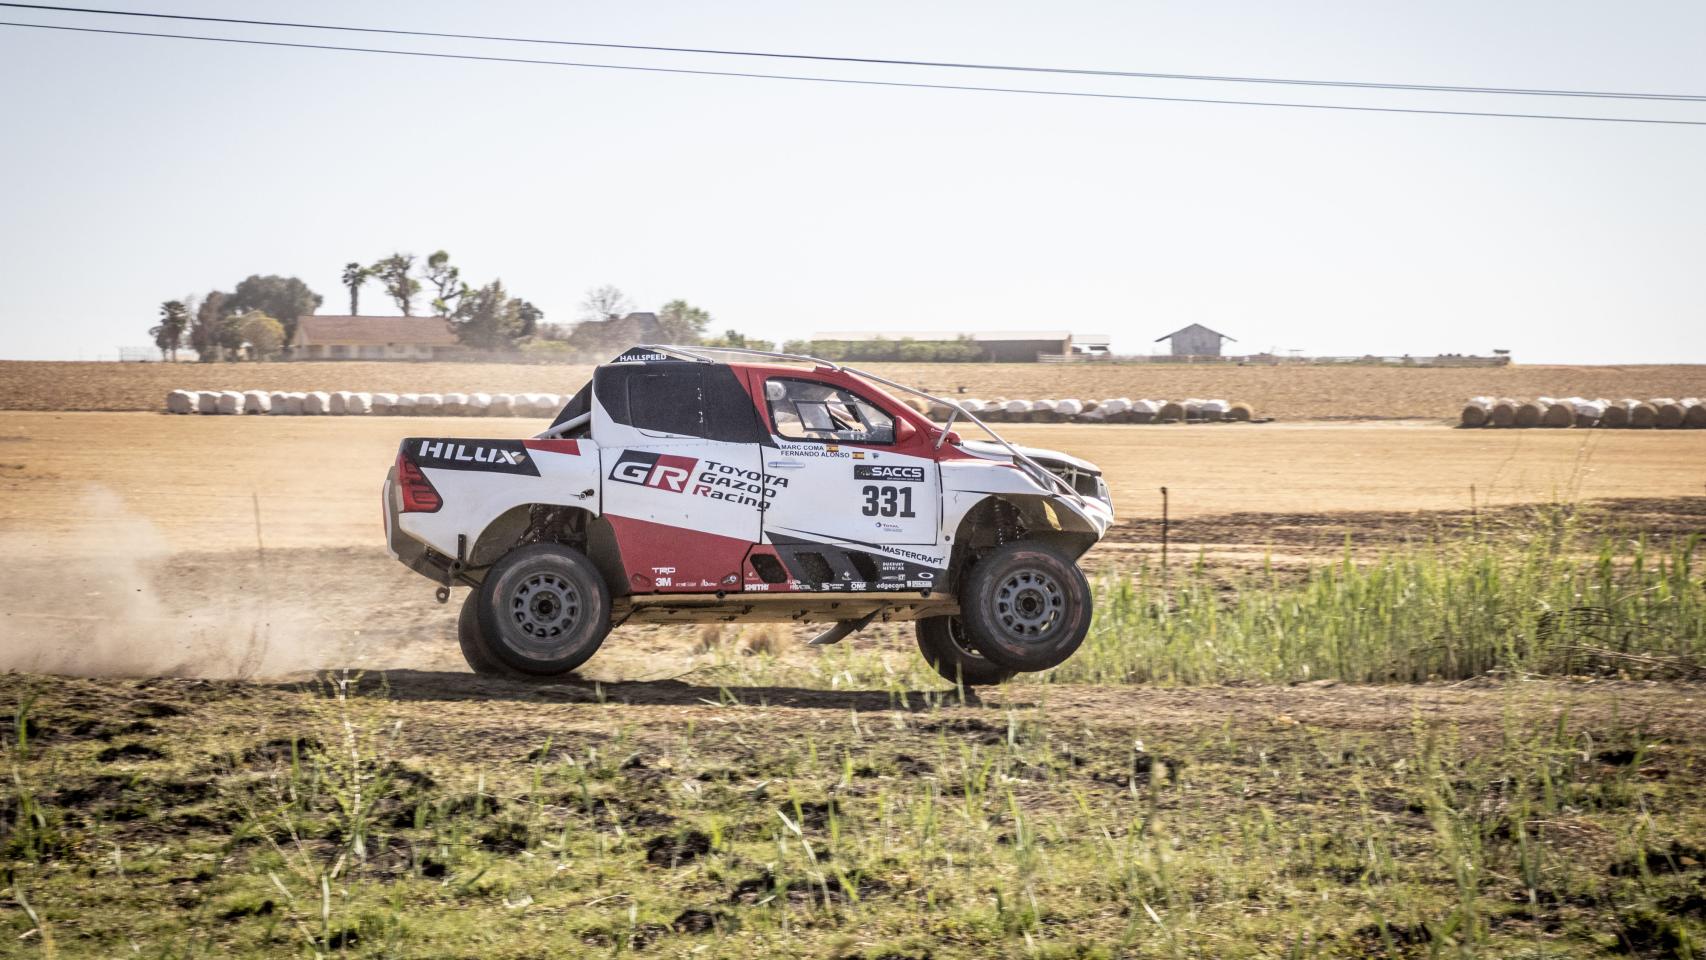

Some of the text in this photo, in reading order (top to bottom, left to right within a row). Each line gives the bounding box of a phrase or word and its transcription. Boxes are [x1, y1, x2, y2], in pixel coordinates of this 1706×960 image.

[620, 353, 667, 362] HALLSPEED
[419, 440, 526, 465] HILUX
[780, 450, 850, 459] FERNANDO ALONSO
[613, 461, 689, 493] GR
[704, 460, 789, 488] TOYOTA
[871, 466, 922, 478] SACCS
[699, 472, 777, 498] GAZOO
[692, 484, 771, 512] Racing
[862, 485, 916, 518] 331
[881, 545, 944, 565] MASTERCRAFT
[651, 567, 676, 575] TRD
[655, 577, 672, 587] 3M
